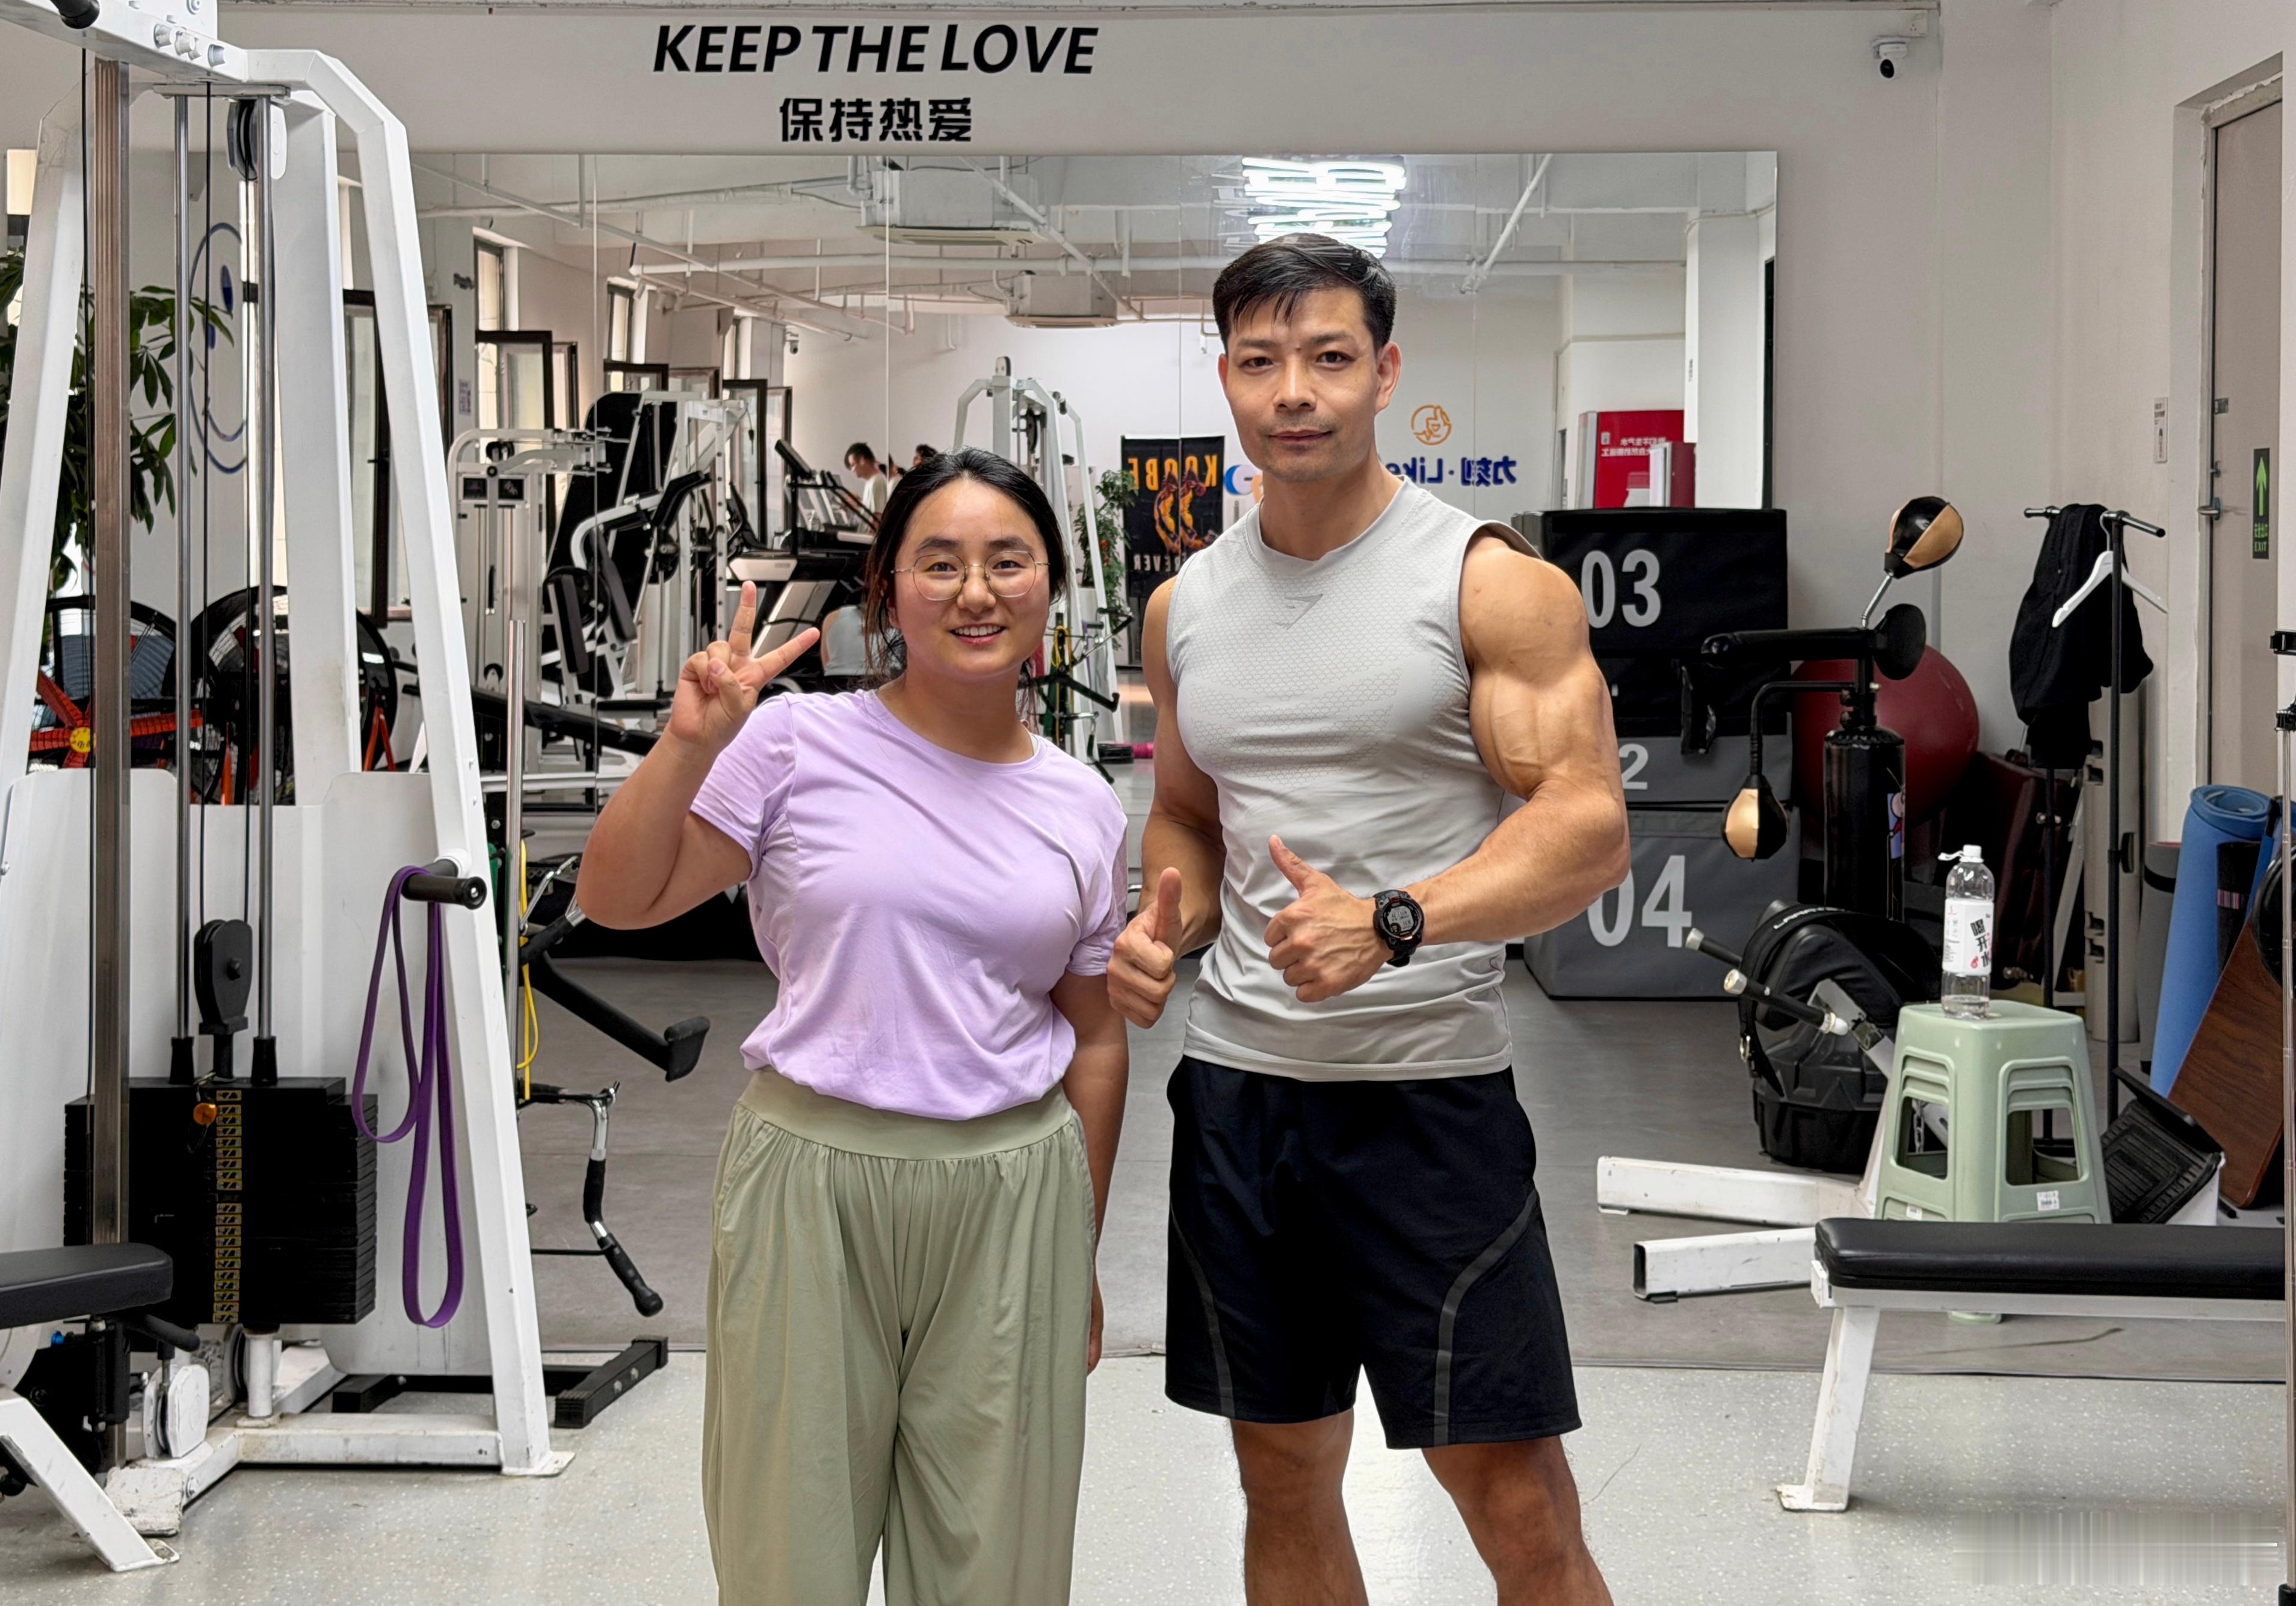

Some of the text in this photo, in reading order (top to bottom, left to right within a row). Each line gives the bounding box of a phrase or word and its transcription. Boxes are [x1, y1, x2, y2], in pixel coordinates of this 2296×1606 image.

[653, 23, 1099, 75] KEEP THE LOVE
[779, 97, 972, 142] 保持热爱
[1581, 549, 1661, 629] 03
[1587, 855, 1692, 948] 04
